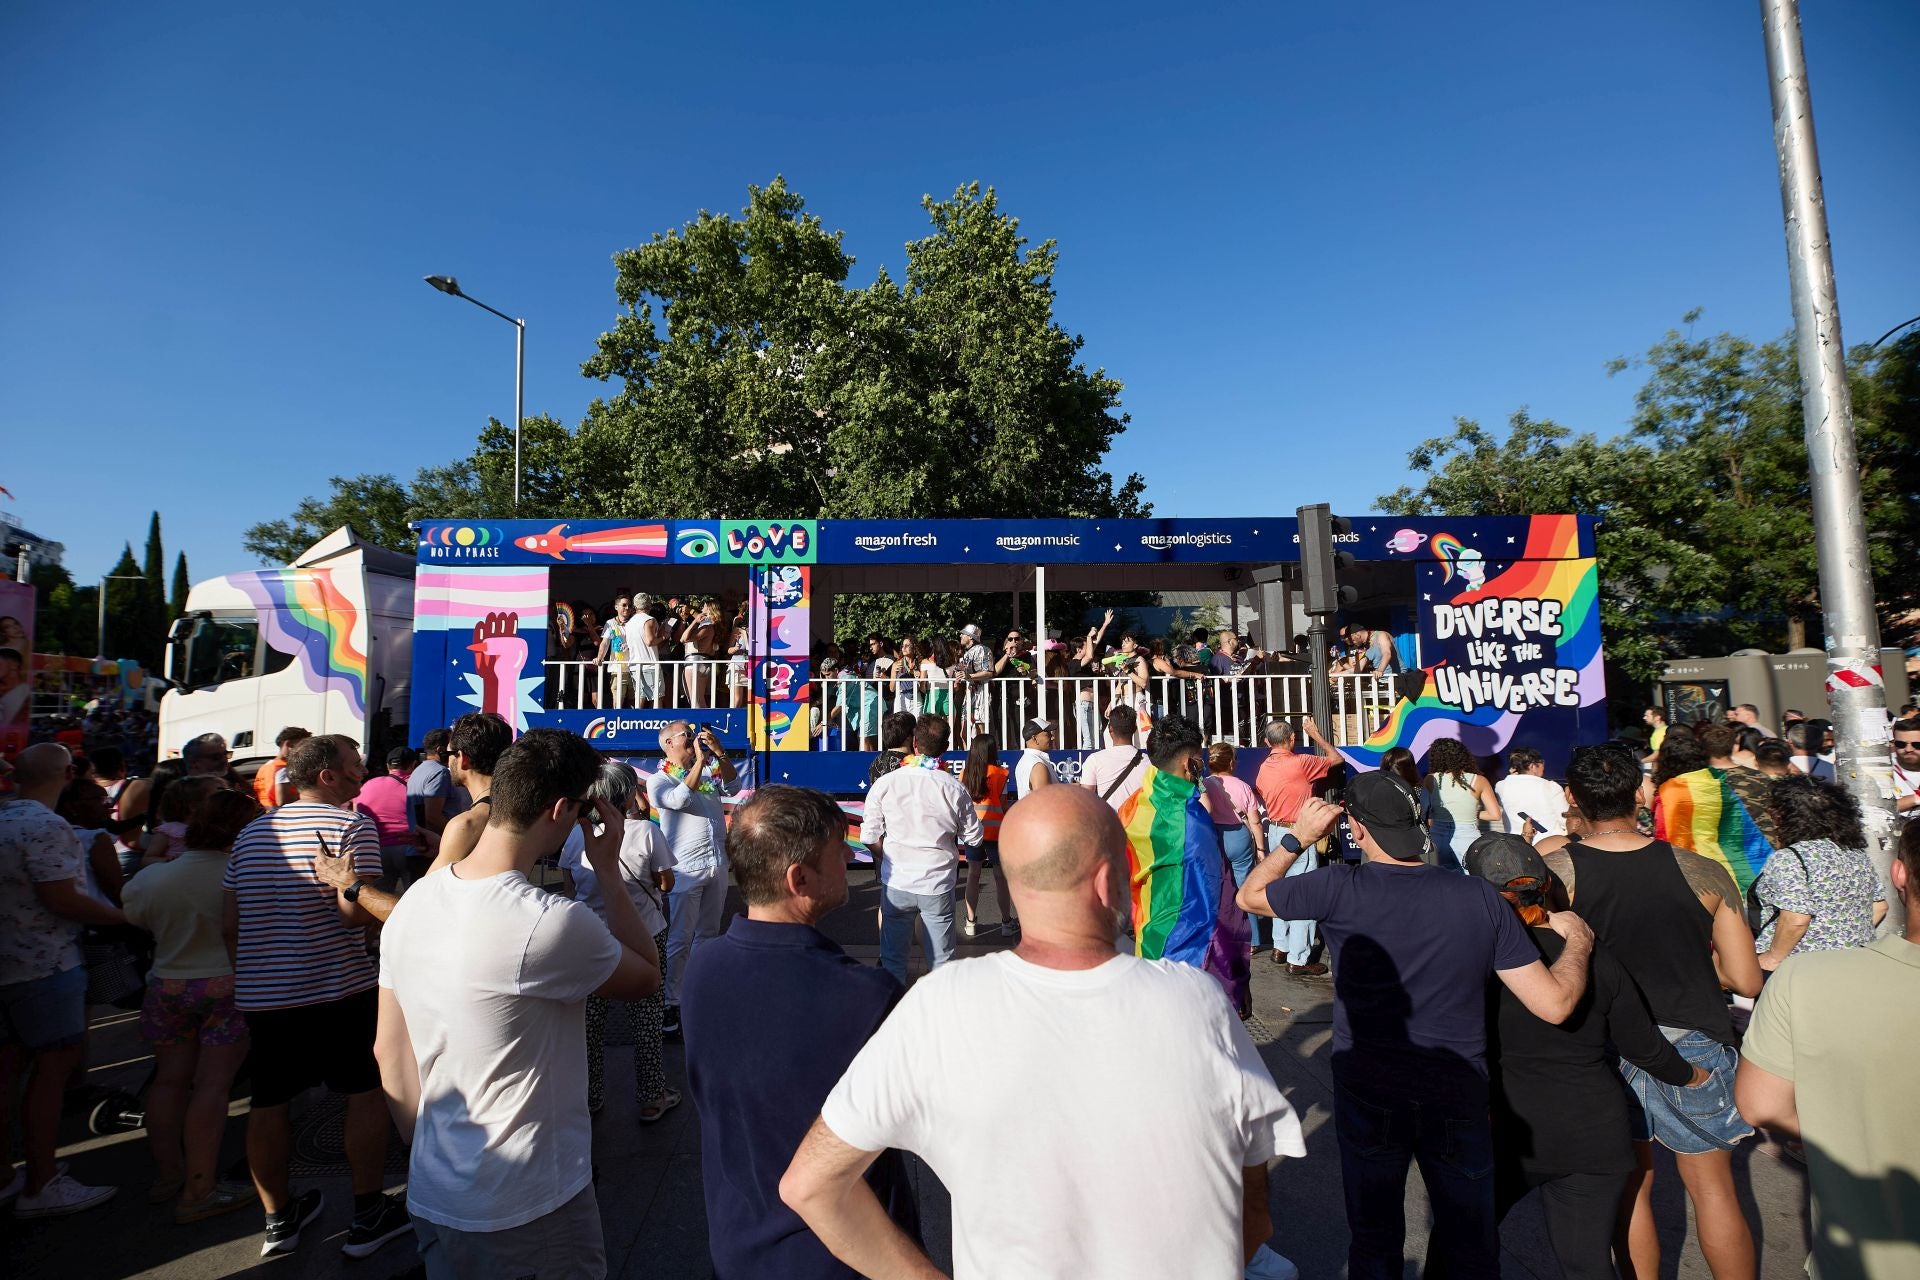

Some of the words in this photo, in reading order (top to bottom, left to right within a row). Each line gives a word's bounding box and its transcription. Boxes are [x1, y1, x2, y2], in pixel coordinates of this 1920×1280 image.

[727, 527, 806, 554] LOVE
[855, 535, 900, 549] amazon
[903, 533, 937, 546] fresh
[996, 535, 1041, 549] amazon
[1043, 534, 1080, 546] music
[430, 547, 450, 558] NOT
[455, 547, 461, 558] A
[465, 547, 499, 558] PHASE
[1512, 643, 1543, 663] THE
[606, 716, 678, 739] glamazo
